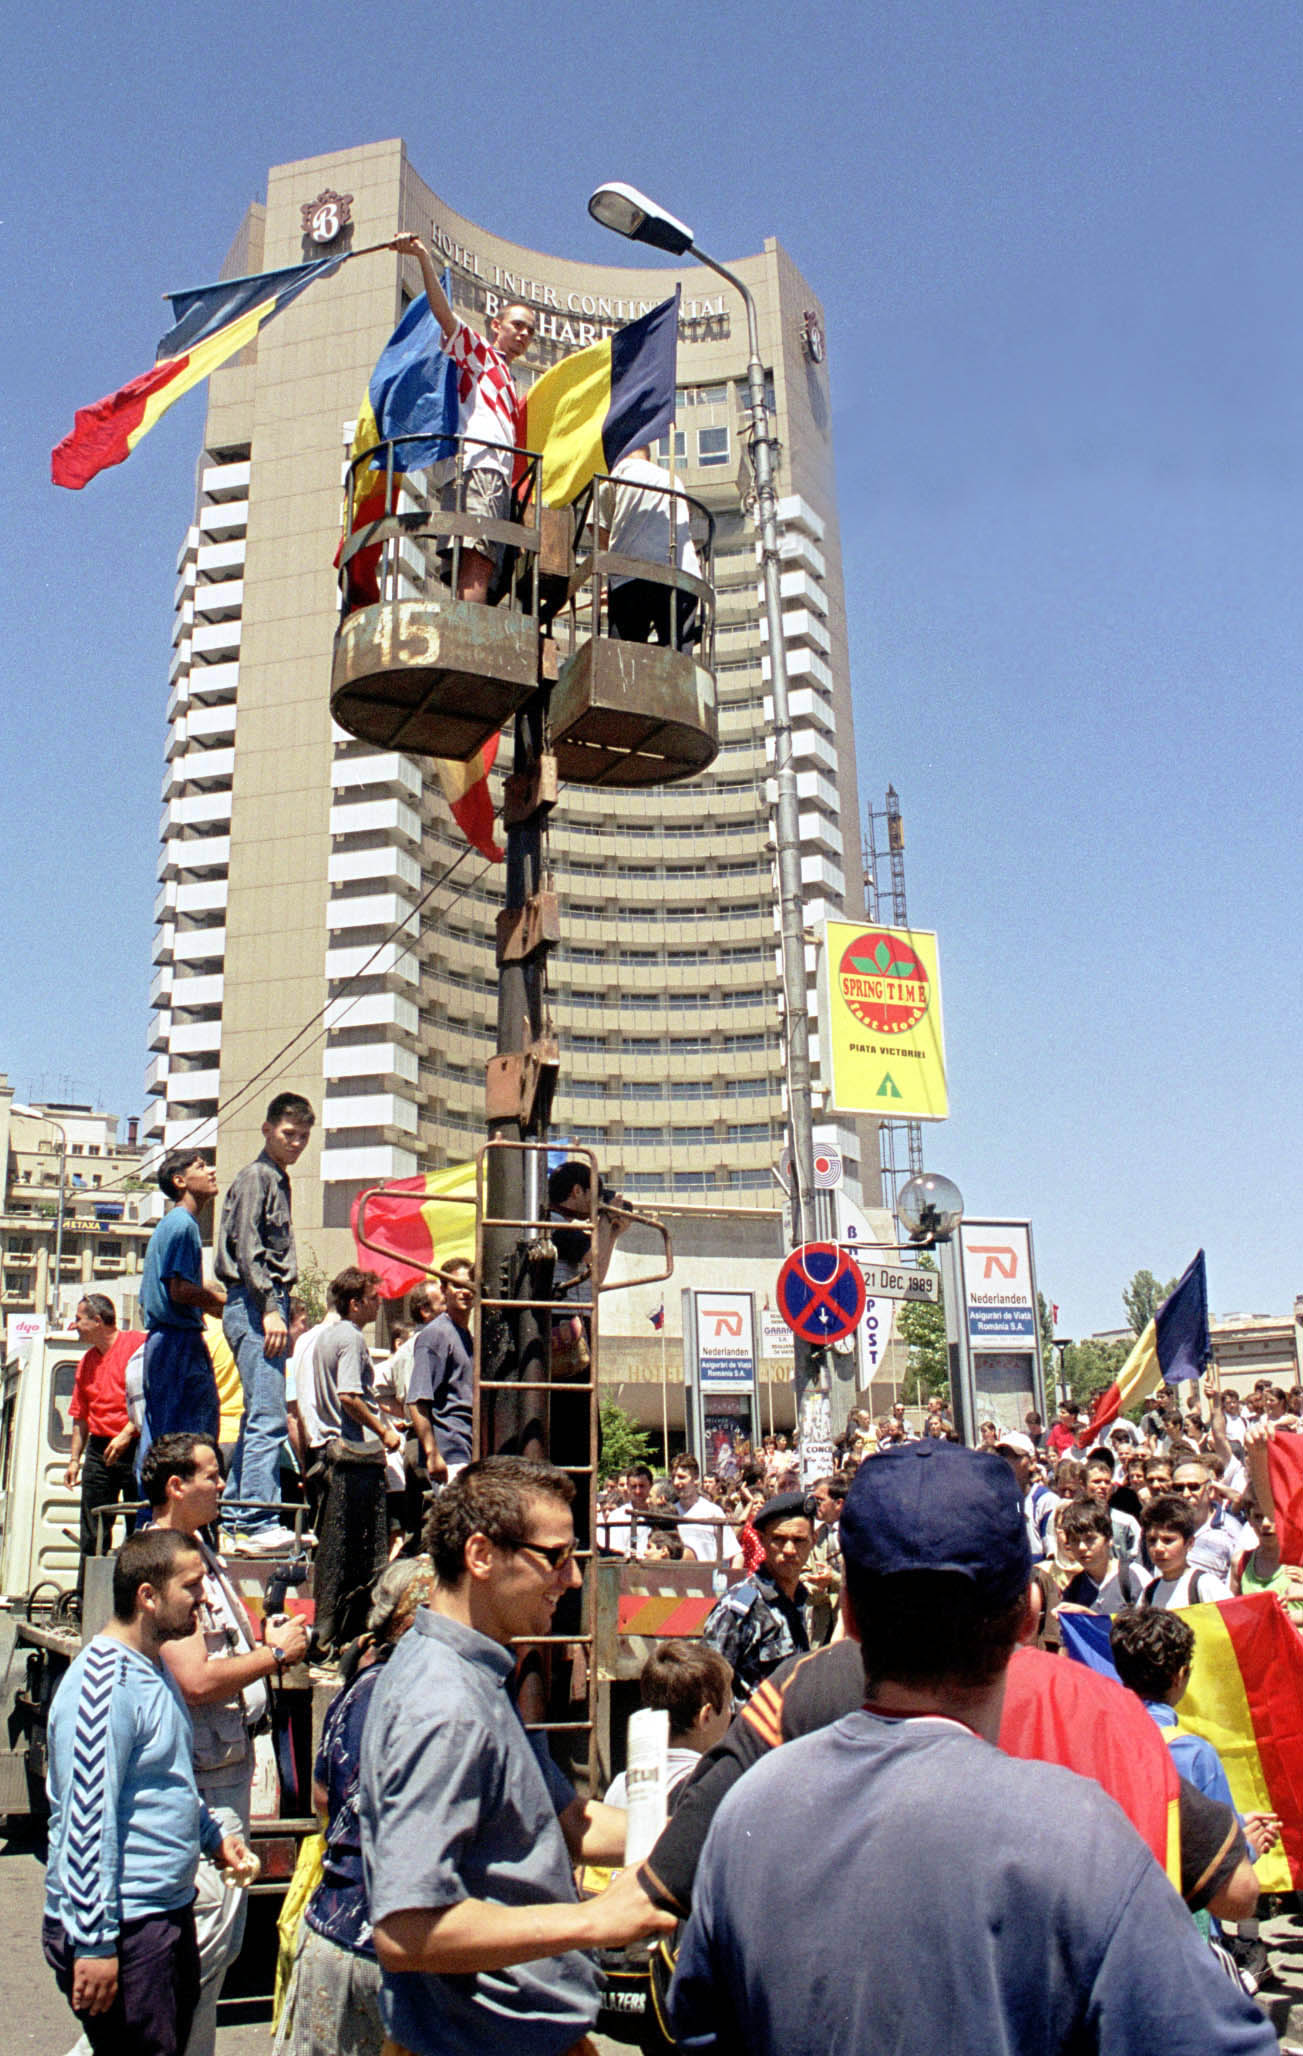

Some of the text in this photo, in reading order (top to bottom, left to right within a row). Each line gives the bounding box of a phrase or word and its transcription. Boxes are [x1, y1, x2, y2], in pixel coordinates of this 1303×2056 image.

[432, 221, 485, 279] HOTEL
[843, 977, 927, 1003] SPRING TIME
[849, 1003, 922, 1033] fast food
[62, 1221, 101, 1230] METAXA
[864, 1272, 876, 1287] 21
[908, 1276, 933, 1292] 1989
[970, 1293, 1028, 1305] Nederlanden
[1003, 1311, 1013, 1320] de
[866, 1299, 879, 1364] POST
[702, 1347, 749, 1356] Nederlanden
